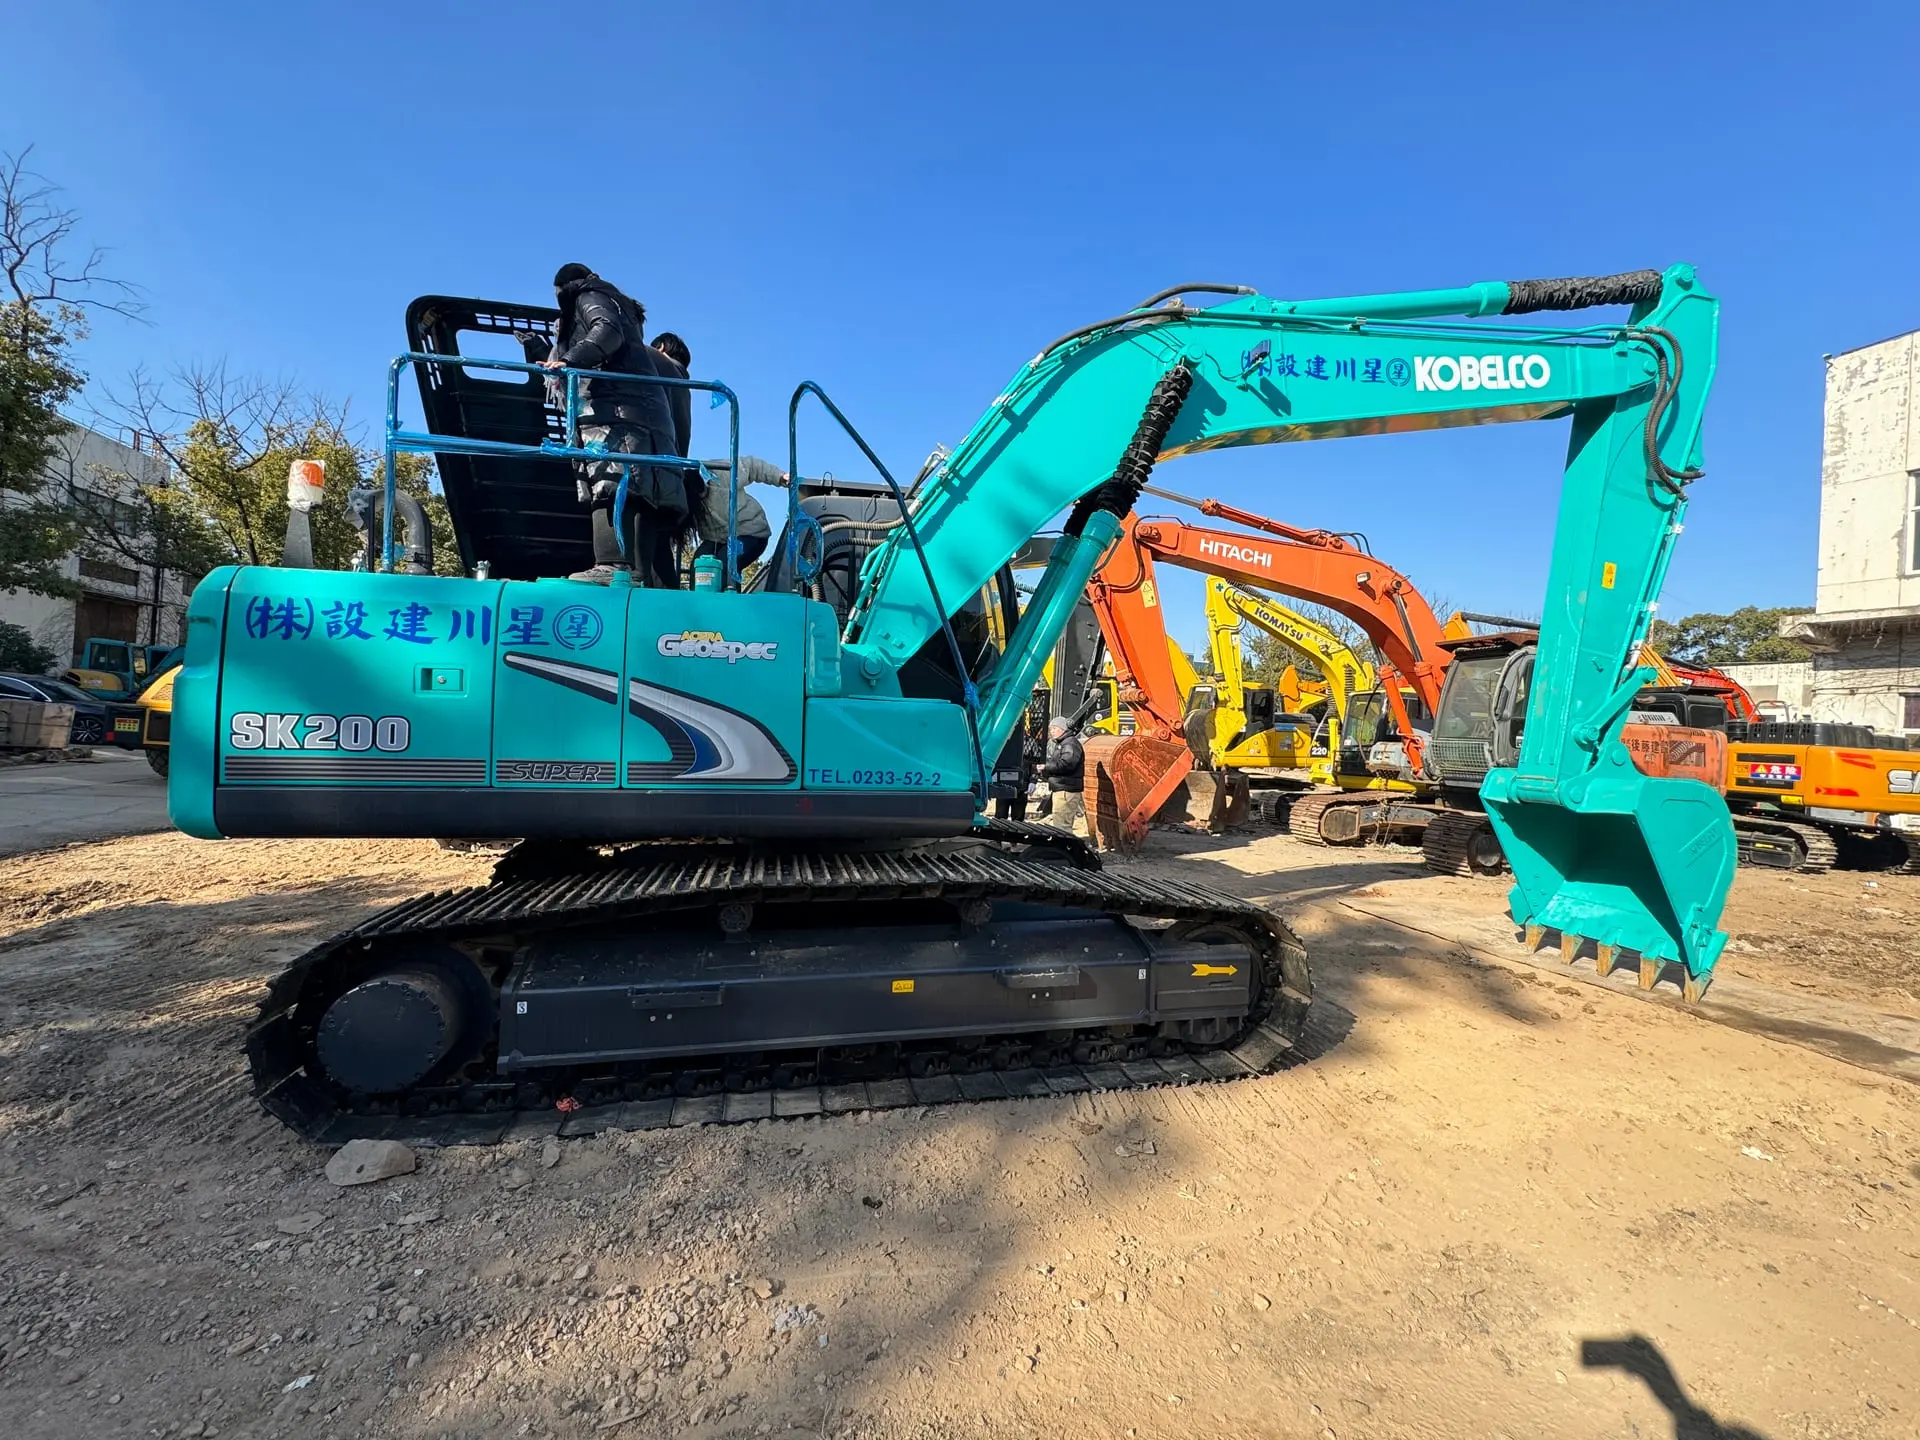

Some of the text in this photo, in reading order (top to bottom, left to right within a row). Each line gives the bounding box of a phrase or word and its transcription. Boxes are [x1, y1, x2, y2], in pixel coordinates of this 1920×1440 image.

[1413, 354, 1551, 392] KOBELCO
[1199, 538, 1272, 568] HITACHI
[680, 630, 723, 642] ACERA
[1254, 607, 1304, 641] KOMATSU
[657, 633, 779, 664] Geospec
[230, 712, 410, 752] SK200
[1311, 747, 1328, 756] 220
[511, 763, 601, 782] SUPER
